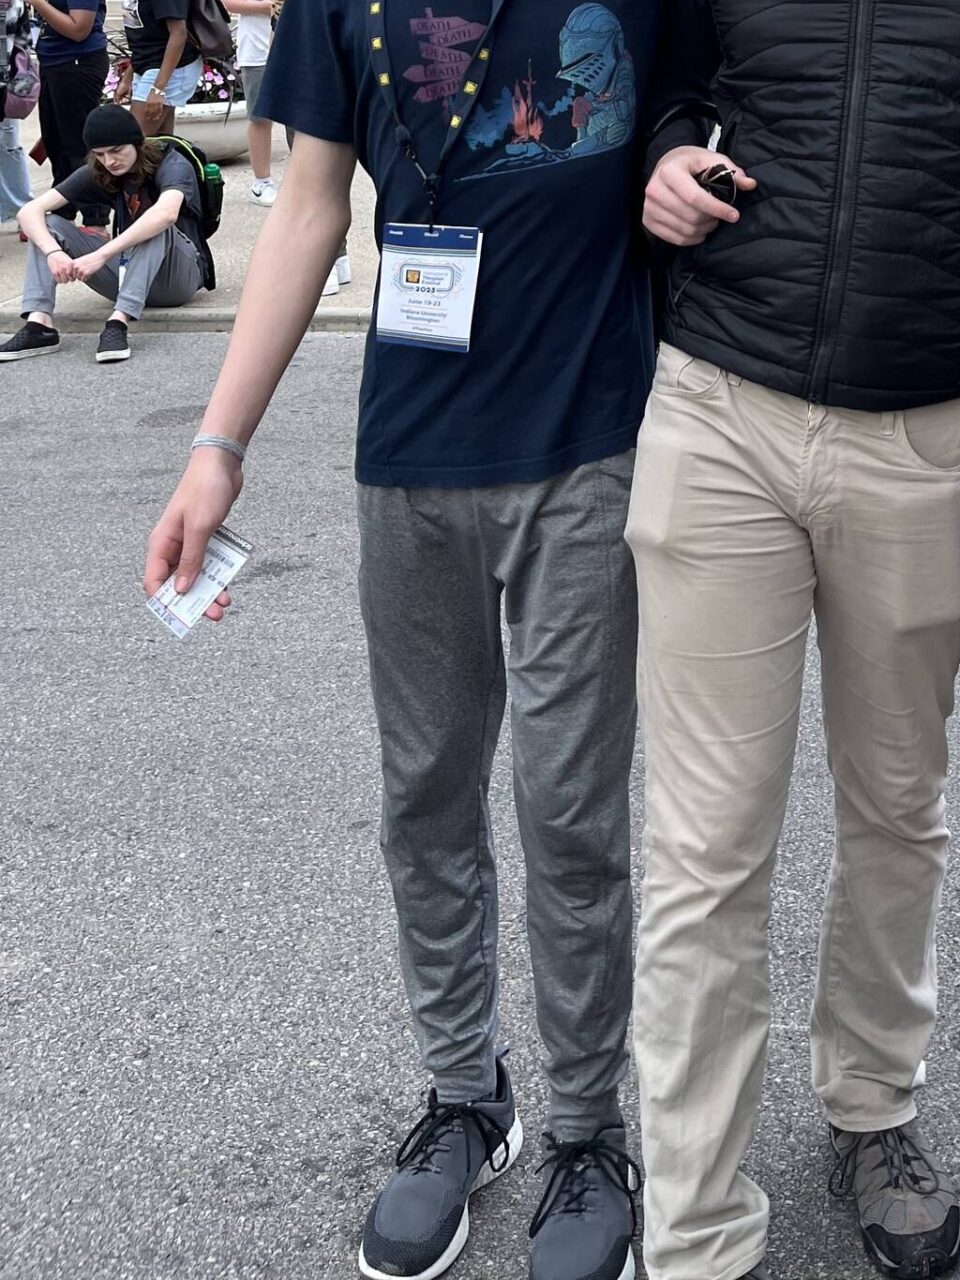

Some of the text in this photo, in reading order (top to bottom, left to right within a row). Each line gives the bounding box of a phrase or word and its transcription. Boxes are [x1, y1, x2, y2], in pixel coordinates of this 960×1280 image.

[416, 21, 451, 31] DEATH
[438, 29, 472, 44] DEATH
[425, 46, 463, 61] DEATH
[424, 65, 460, 77] DEATH
